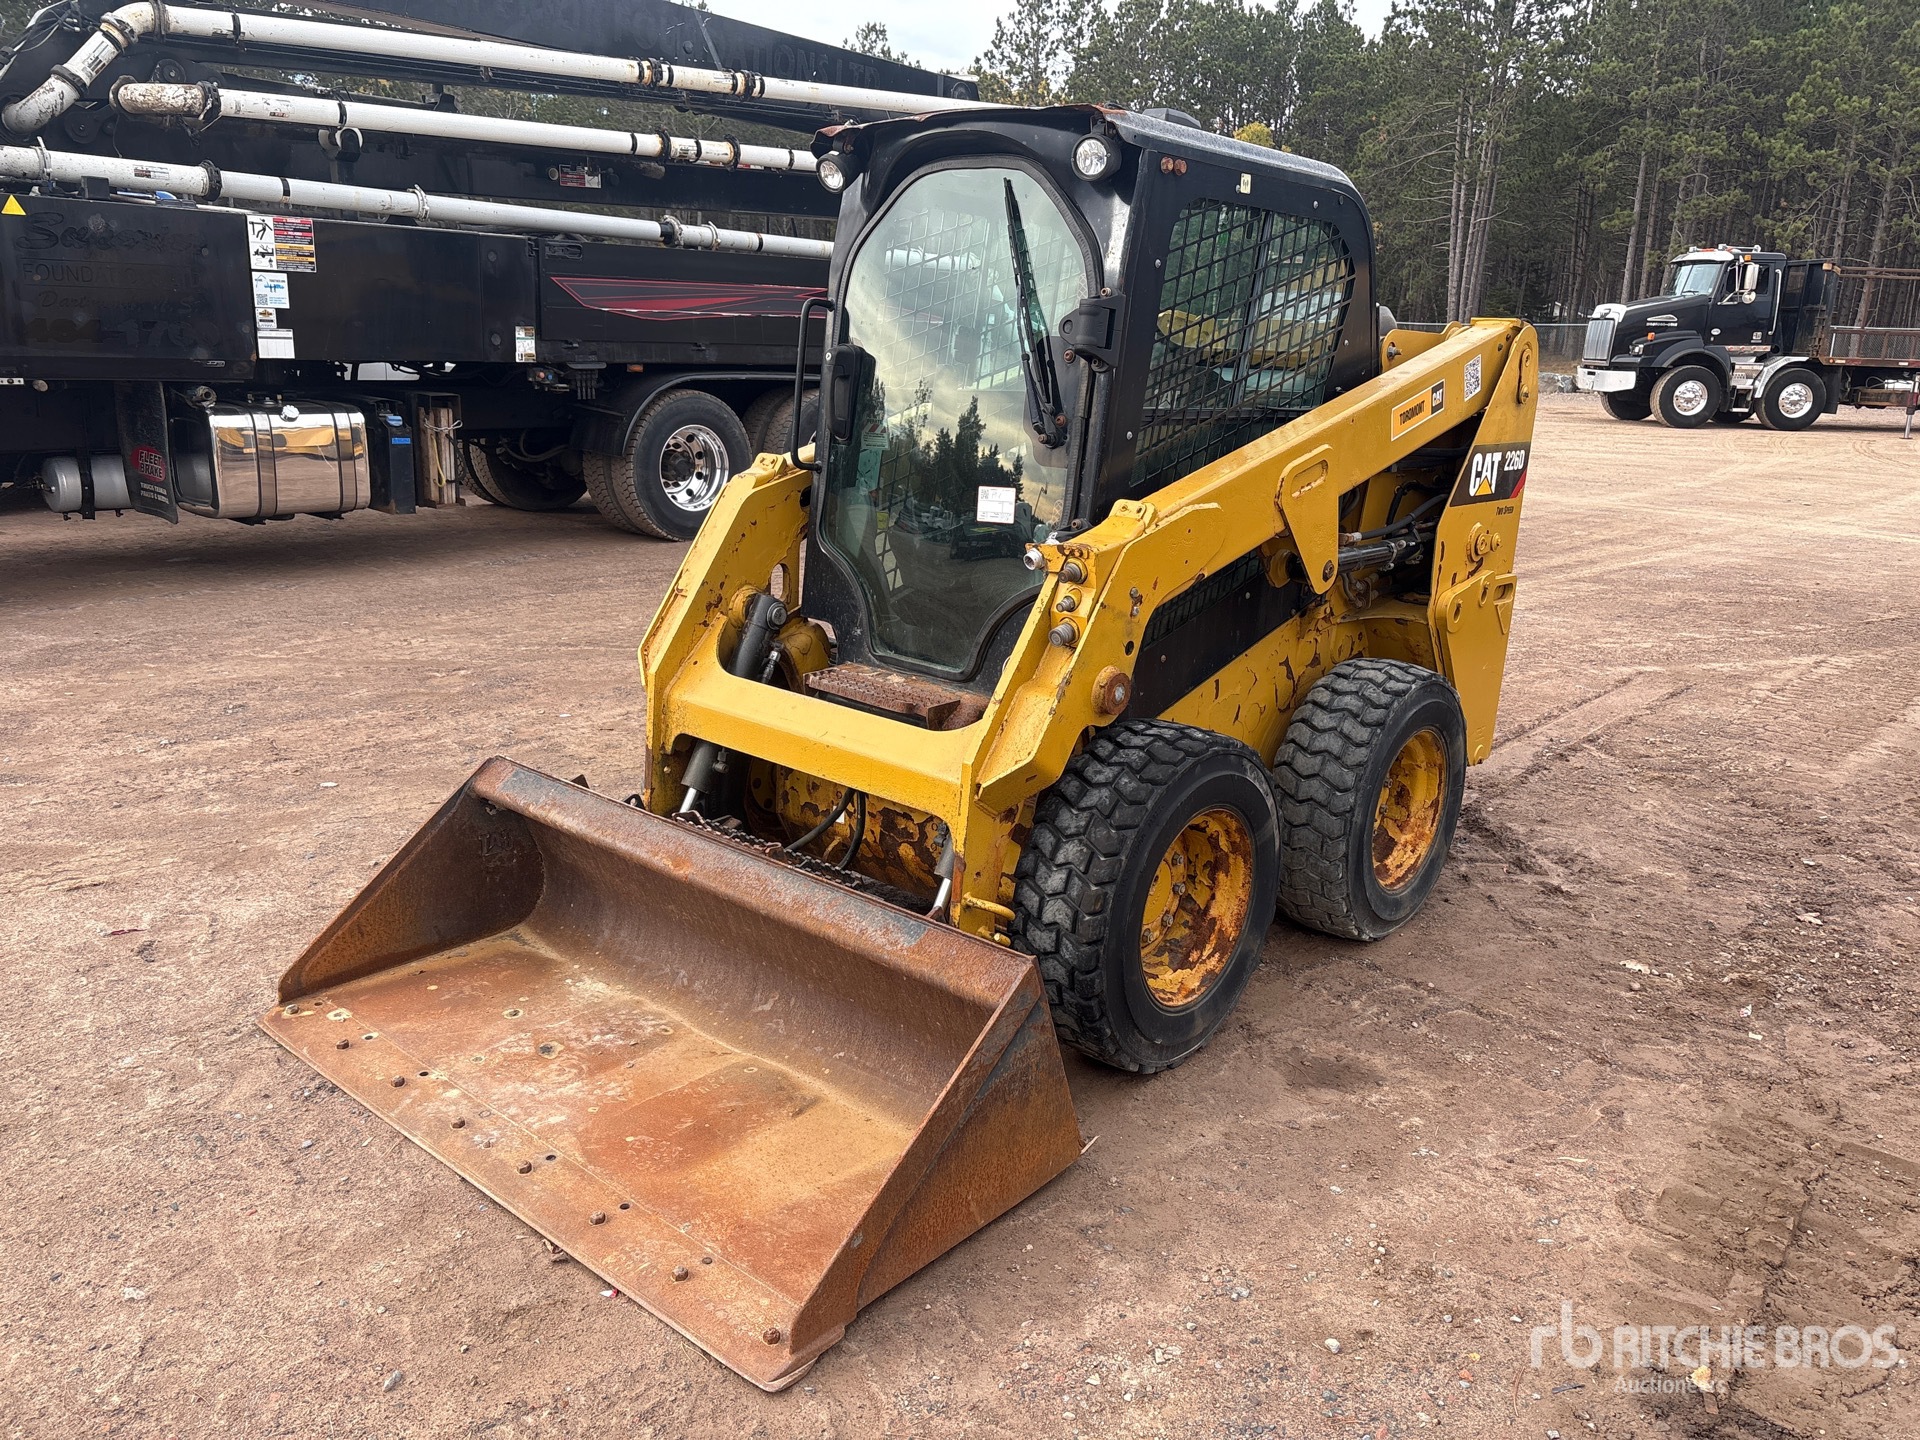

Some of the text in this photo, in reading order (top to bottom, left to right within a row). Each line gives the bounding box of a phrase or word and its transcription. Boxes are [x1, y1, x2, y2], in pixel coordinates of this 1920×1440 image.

[1399, 388, 1443, 426] TOROMONT CAT
[139, 450, 162, 466] FLEET
[140, 462, 163, 479] BRAKE
[1469, 450, 1525, 497] CAT 226D
